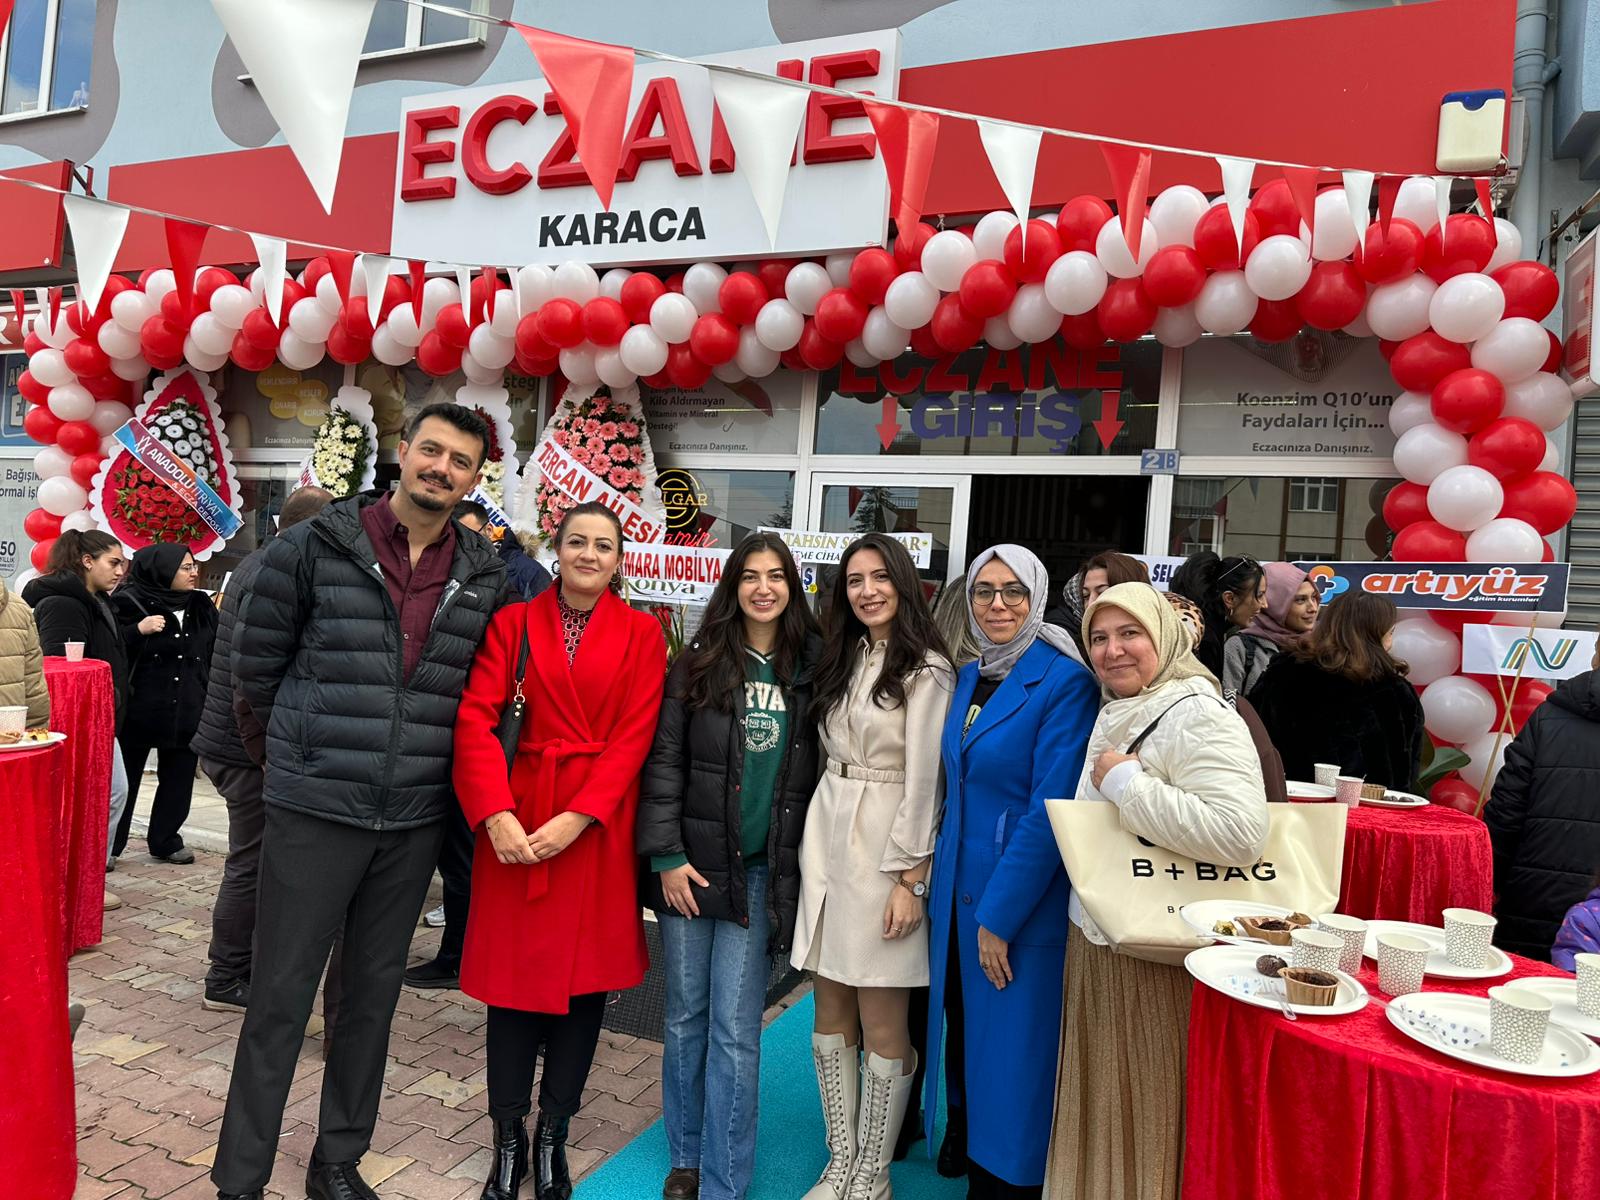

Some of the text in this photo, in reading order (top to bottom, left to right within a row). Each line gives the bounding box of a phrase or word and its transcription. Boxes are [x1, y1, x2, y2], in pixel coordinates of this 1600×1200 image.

[538, 207, 707, 248] KARACA
[1236, 391, 1318, 407] Koenzim
[1241, 412, 1328, 431] Faydaları
[668, 441, 708, 451] Eczacınıza
[1252, 442, 1311, 453] Eczacınıza
[147, 447, 196, 489] ANADOLU
[1145, 453, 1176, 469] 2 B
[537, 441, 593, 502] TERCAN
[783, 532, 837, 549] TAHSİN
[664, 550, 721, 584] MOBİLYA
[1361, 567, 1549, 602] artıyüz
[1195, 861, 1277, 881] BAG
